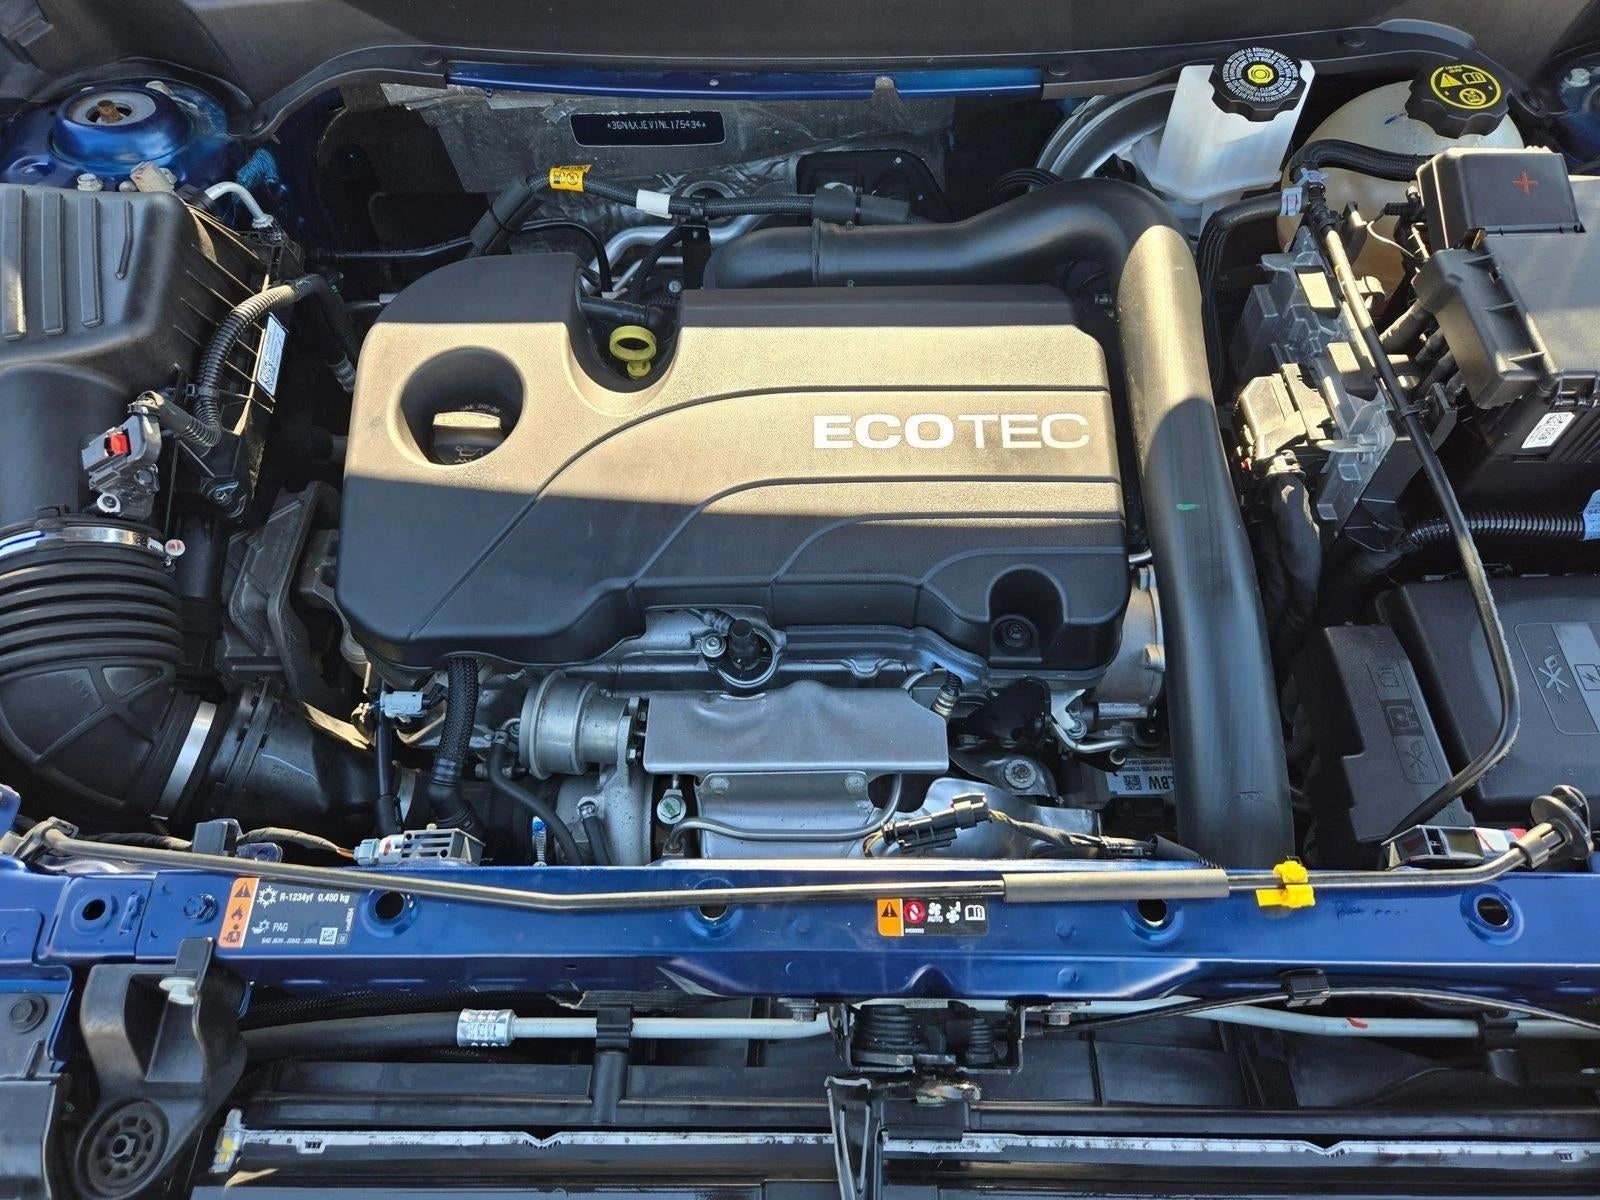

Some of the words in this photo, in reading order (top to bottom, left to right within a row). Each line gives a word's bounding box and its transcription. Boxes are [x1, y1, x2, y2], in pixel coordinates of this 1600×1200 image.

[813, 413, 1090, 449] ECOTEC
[279, 892, 314, 904] R-1234yf
[317, 893, 339, 903] 0.450
[339, 892, 350, 904] kg
[927, 915, 944, 923] AUTO
[272, 922, 289, 932] PAG
